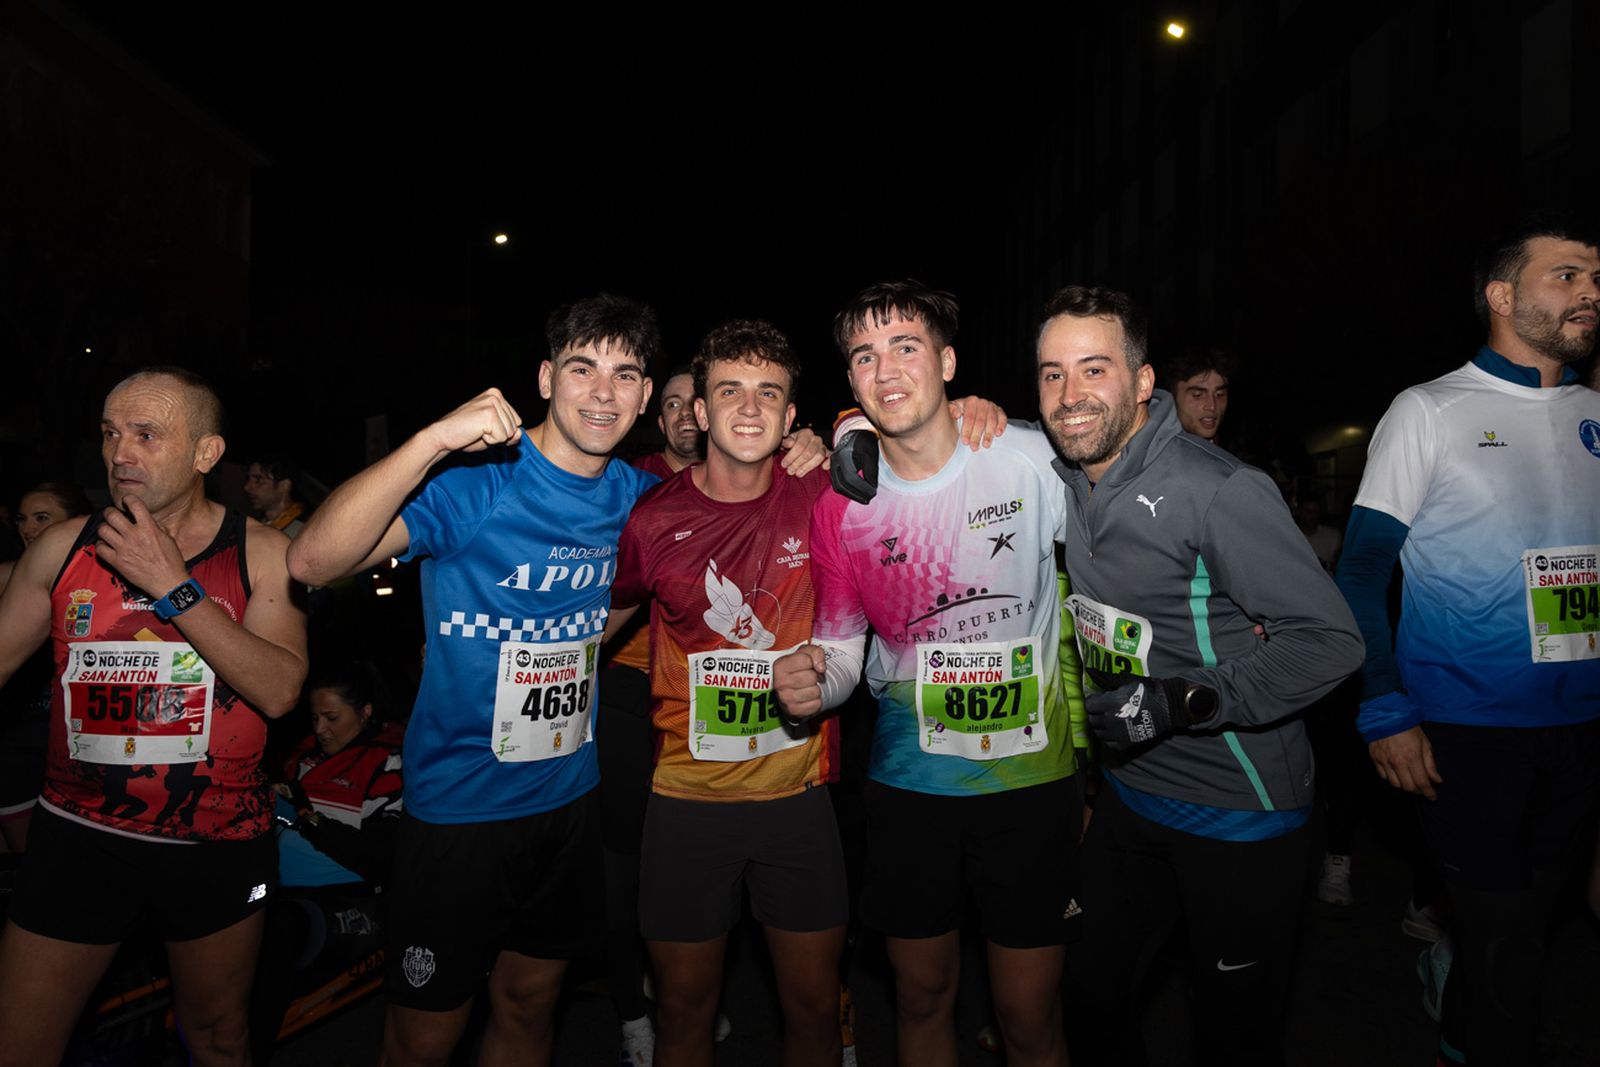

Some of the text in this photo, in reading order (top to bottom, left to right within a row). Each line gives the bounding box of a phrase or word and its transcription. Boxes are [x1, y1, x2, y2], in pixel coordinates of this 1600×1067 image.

[548, 545, 612, 560] ACADEMIA
[880, 552, 907, 567] vive
[1551, 558, 1597, 571] NOCHE DE
[1539, 570, 1598, 587] SAN ANTÓN
[957, 599, 1036, 632] PUERTA
[99, 655, 160, 667] NOCHE DE
[532, 656, 566, 669] NOCHE
[567, 653, 580, 665] DE
[718, 661, 770, 675] NOCHE DE
[946, 656, 1002, 668] NOCHE DE
[79, 666, 158, 682] SAN ANTÓN
[514, 664, 577, 684] SAN ANTÓN
[704, 674, 770, 690] SAN ANTÓN
[932, 671, 956, 684] SAN
[959, 667, 1002, 684] ANTÓN
[520, 678, 589, 721] 4638
[945, 682, 1022, 721] 8627
[549, 720, 568, 731] David
